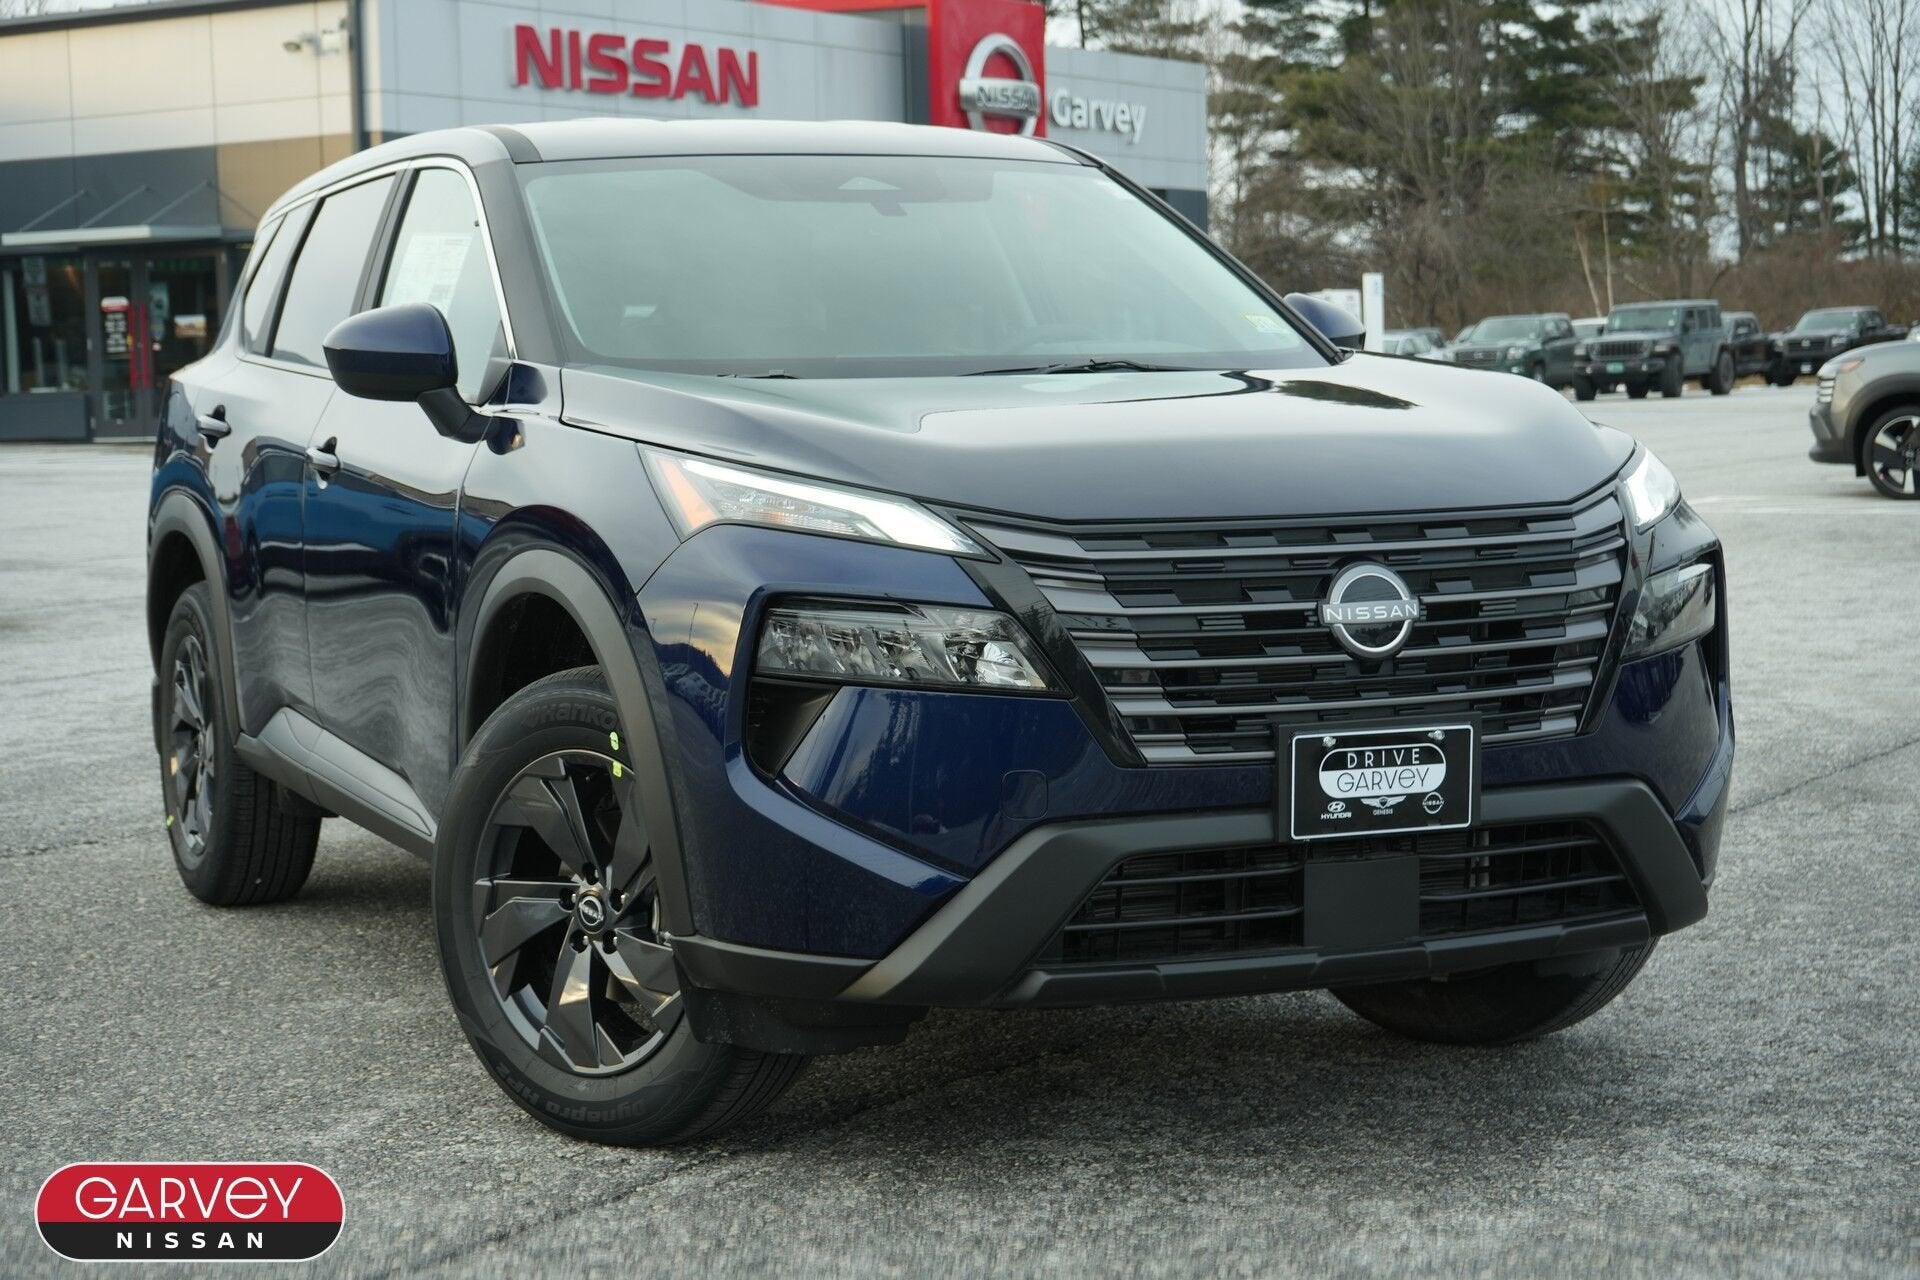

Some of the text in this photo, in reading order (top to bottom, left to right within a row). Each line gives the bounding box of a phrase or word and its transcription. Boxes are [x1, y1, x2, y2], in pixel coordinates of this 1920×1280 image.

[515, 24, 758, 107] NISSAN
[976, 86, 1037, 109] NISSAN
[1052, 88, 1146, 144] Garvey
[1326, 603, 1418, 621] NISSAN
[538, 703, 618, 730] Hanko
[1347, 748, 1420, 769] DRIVE
[1320, 811, 1353, 820] HYUNDAI
[1372, 808, 1394, 816] GENESIS
